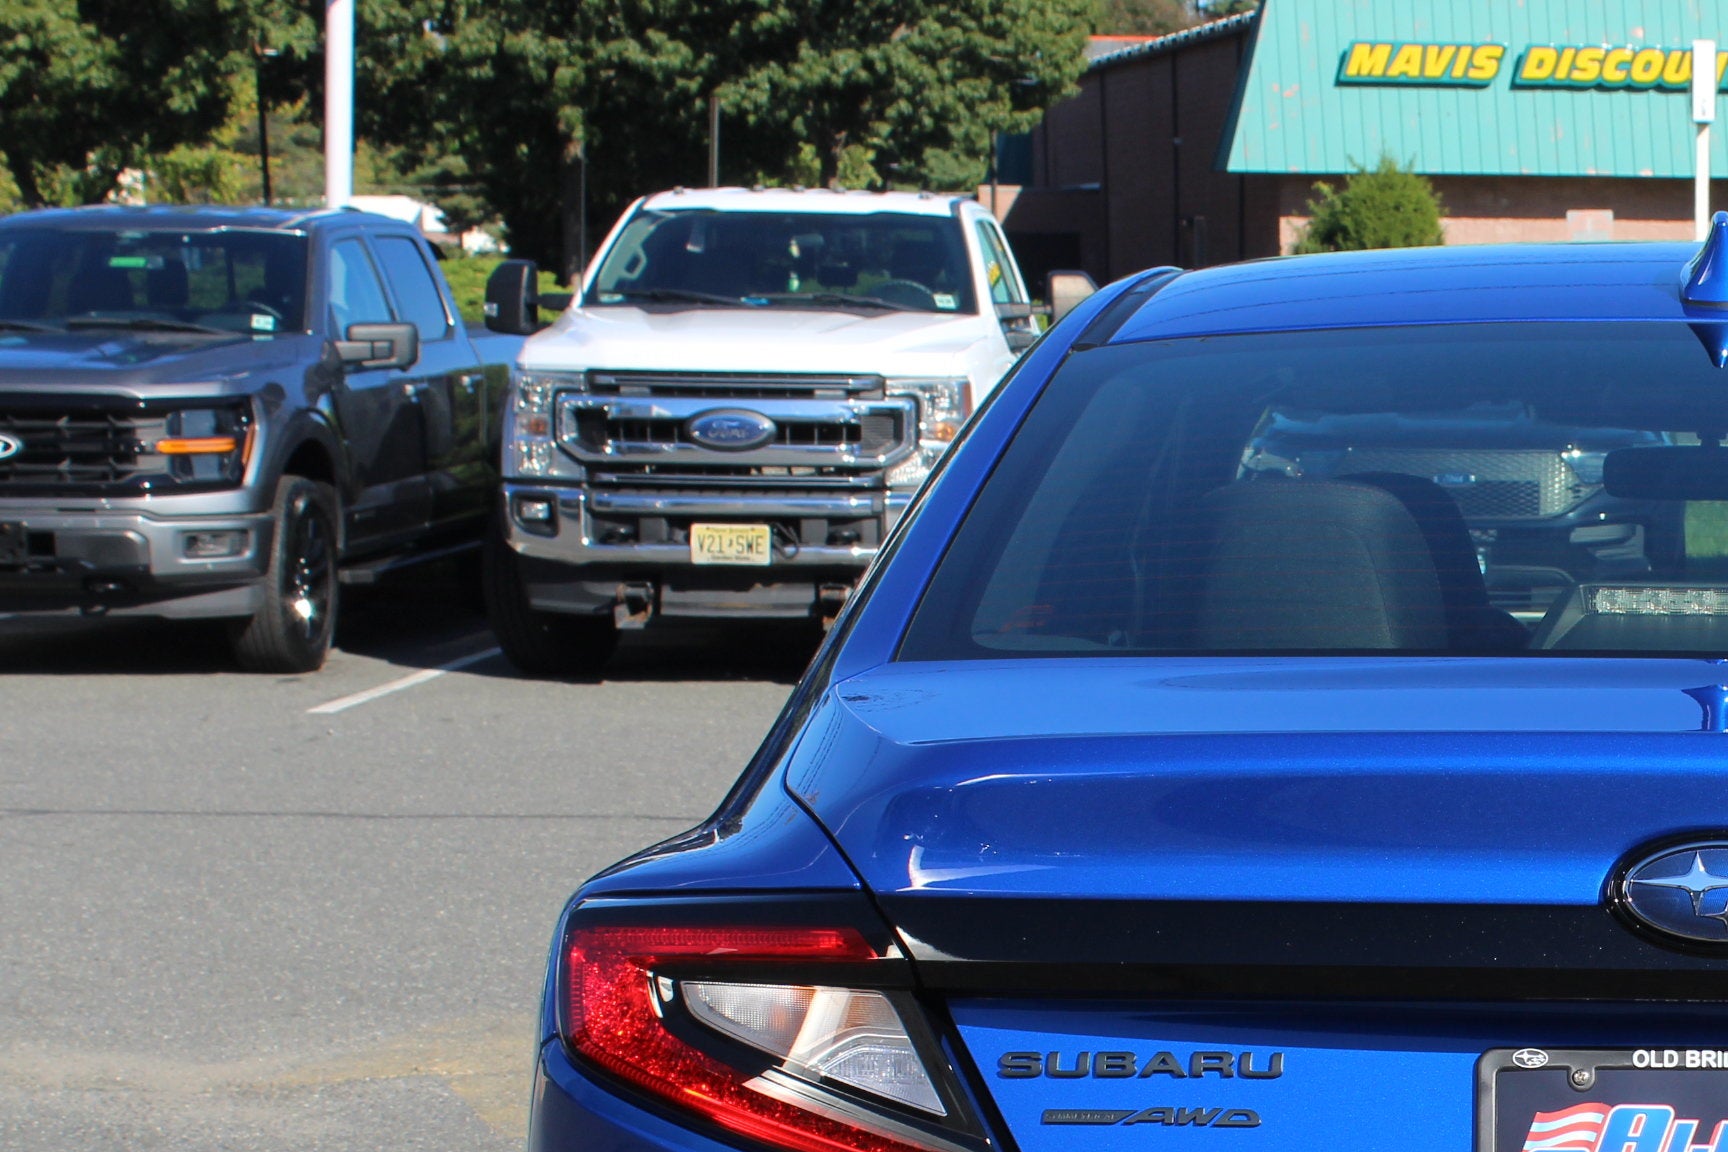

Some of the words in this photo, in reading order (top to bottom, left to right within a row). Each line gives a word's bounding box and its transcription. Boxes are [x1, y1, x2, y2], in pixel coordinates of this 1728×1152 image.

[1345, 43, 1504, 80] MAVIS
[999, 1051, 1285, 1079] SUBARU
[1632, 1049, 1679, 1068] OLD
[1123, 1107, 1262, 1127] AWD
